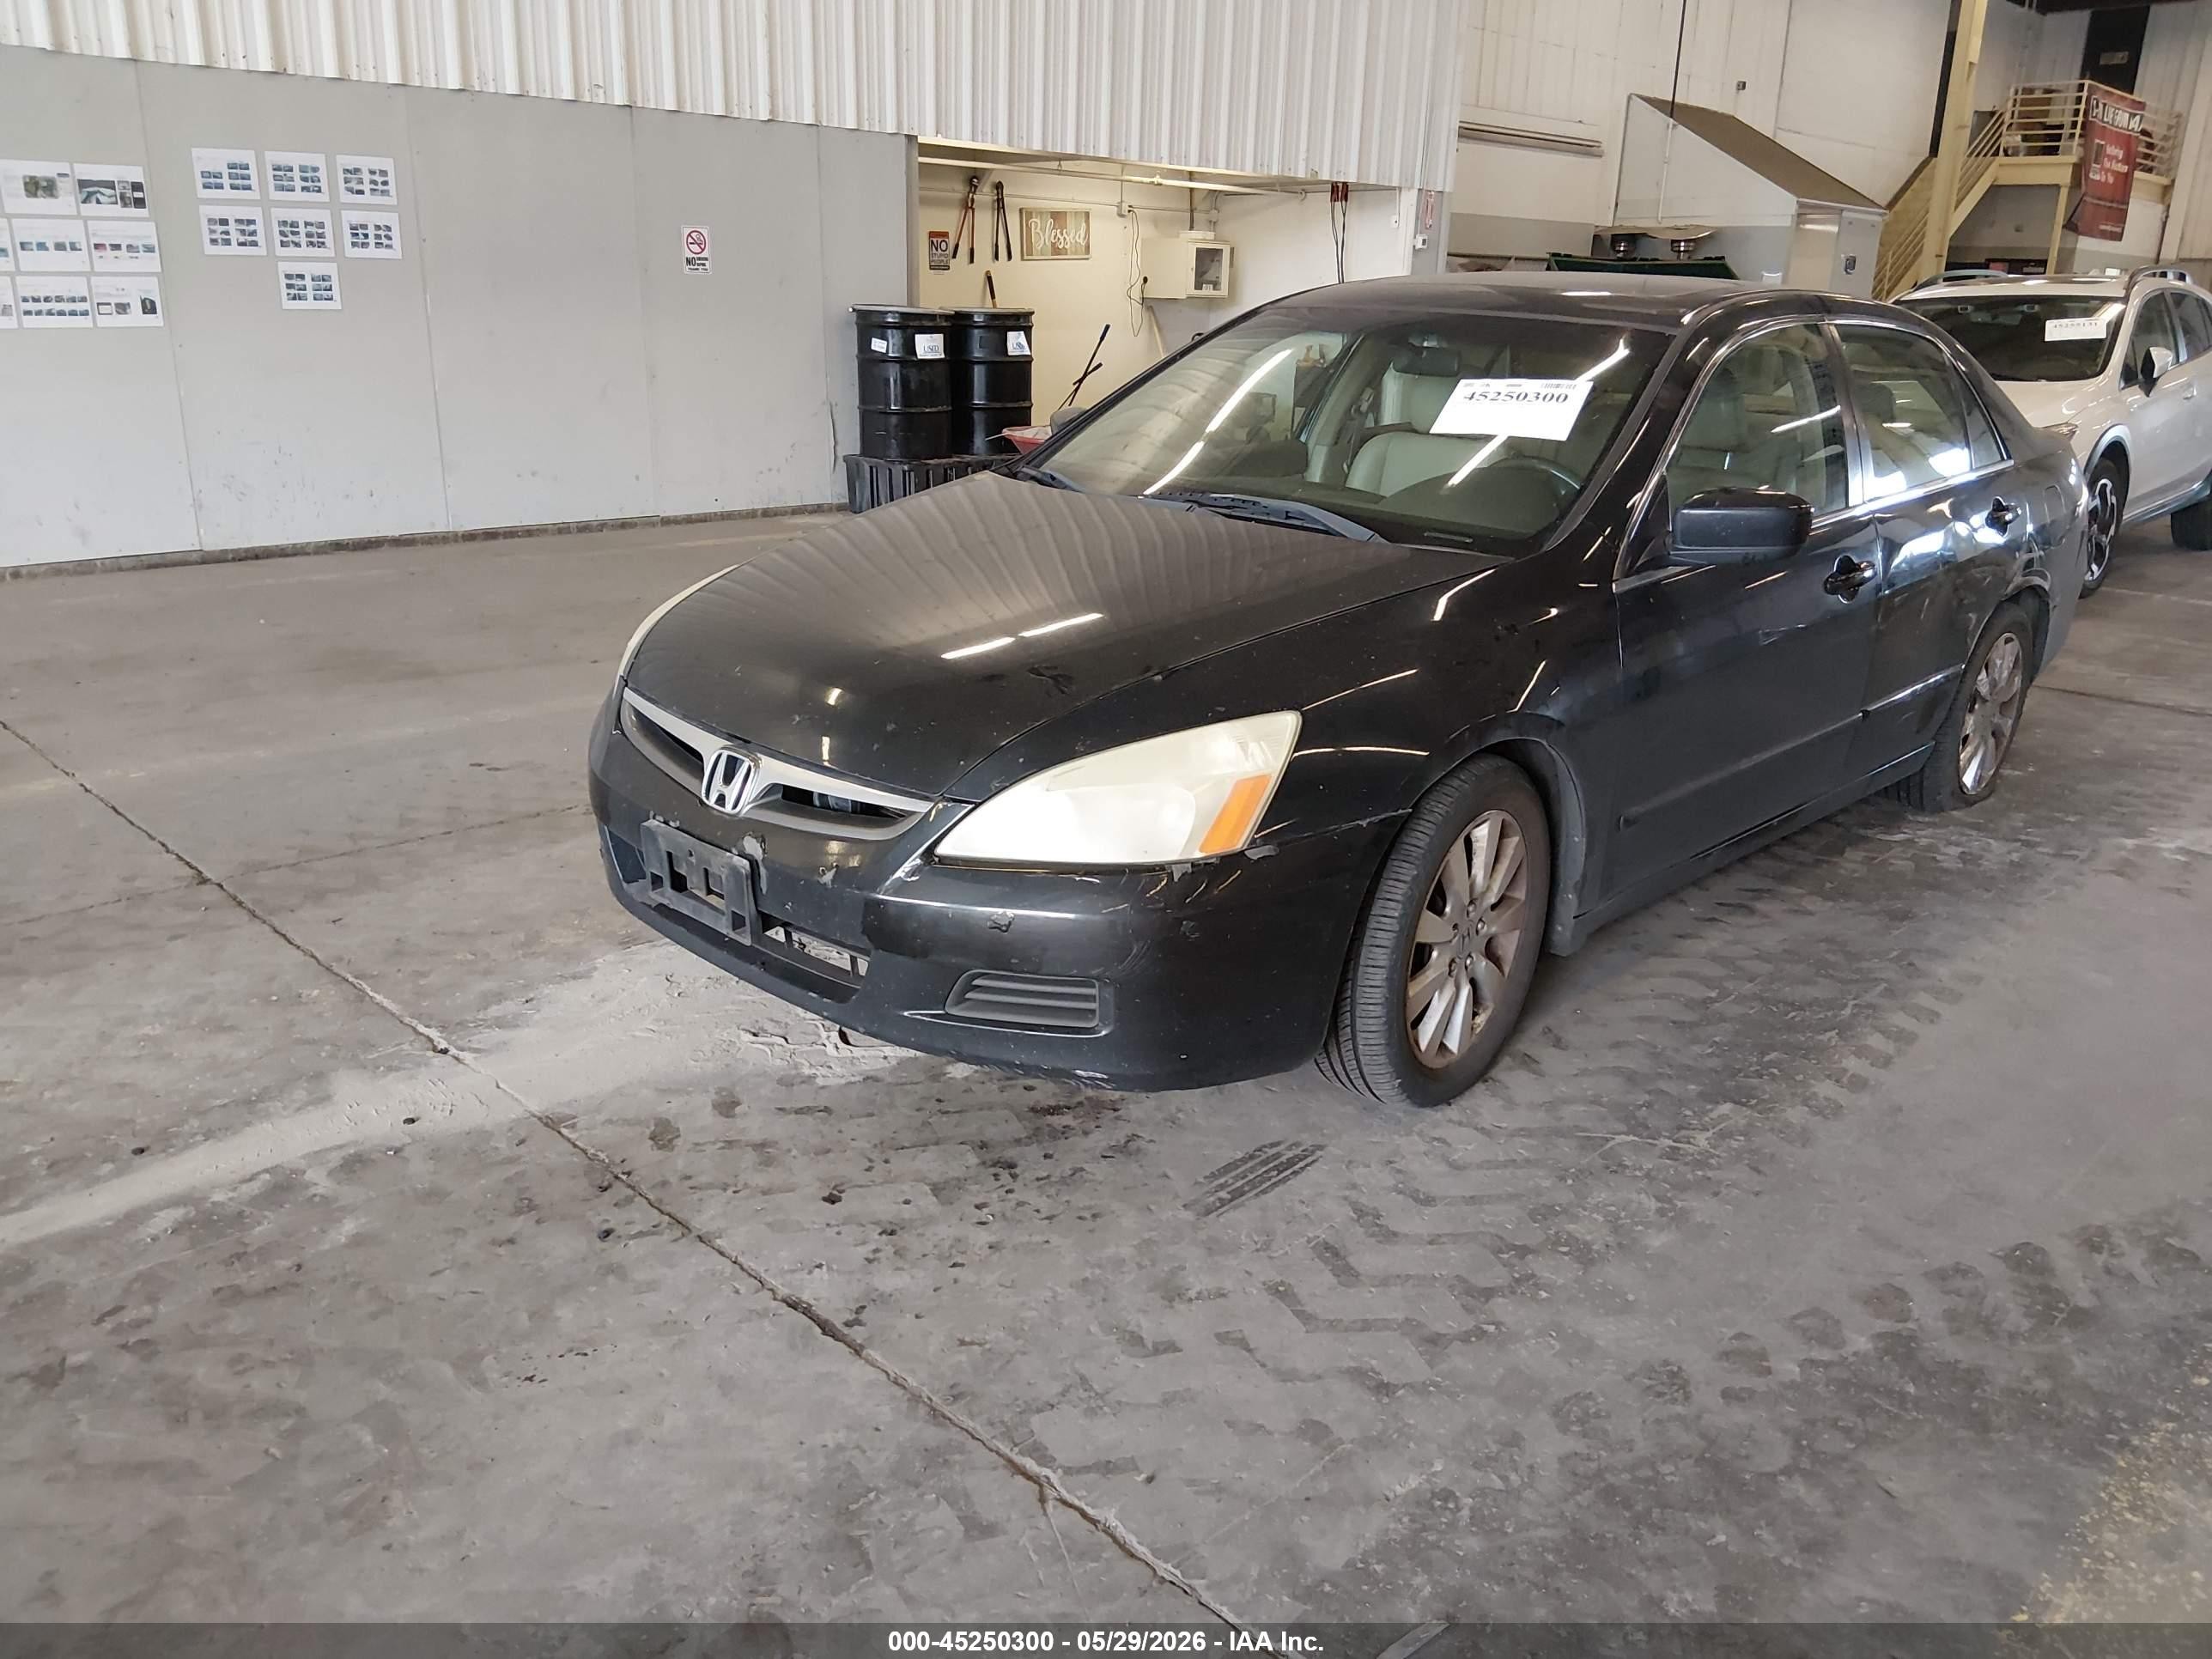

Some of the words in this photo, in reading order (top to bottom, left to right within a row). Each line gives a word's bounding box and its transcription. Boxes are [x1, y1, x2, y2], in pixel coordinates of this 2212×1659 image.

[1028, 218, 1089, 249] Blessed
[930, 239, 949, 252] NO
[685, 256, 696, 267] NO
[1462, 391, 1569, 404] 45250300
